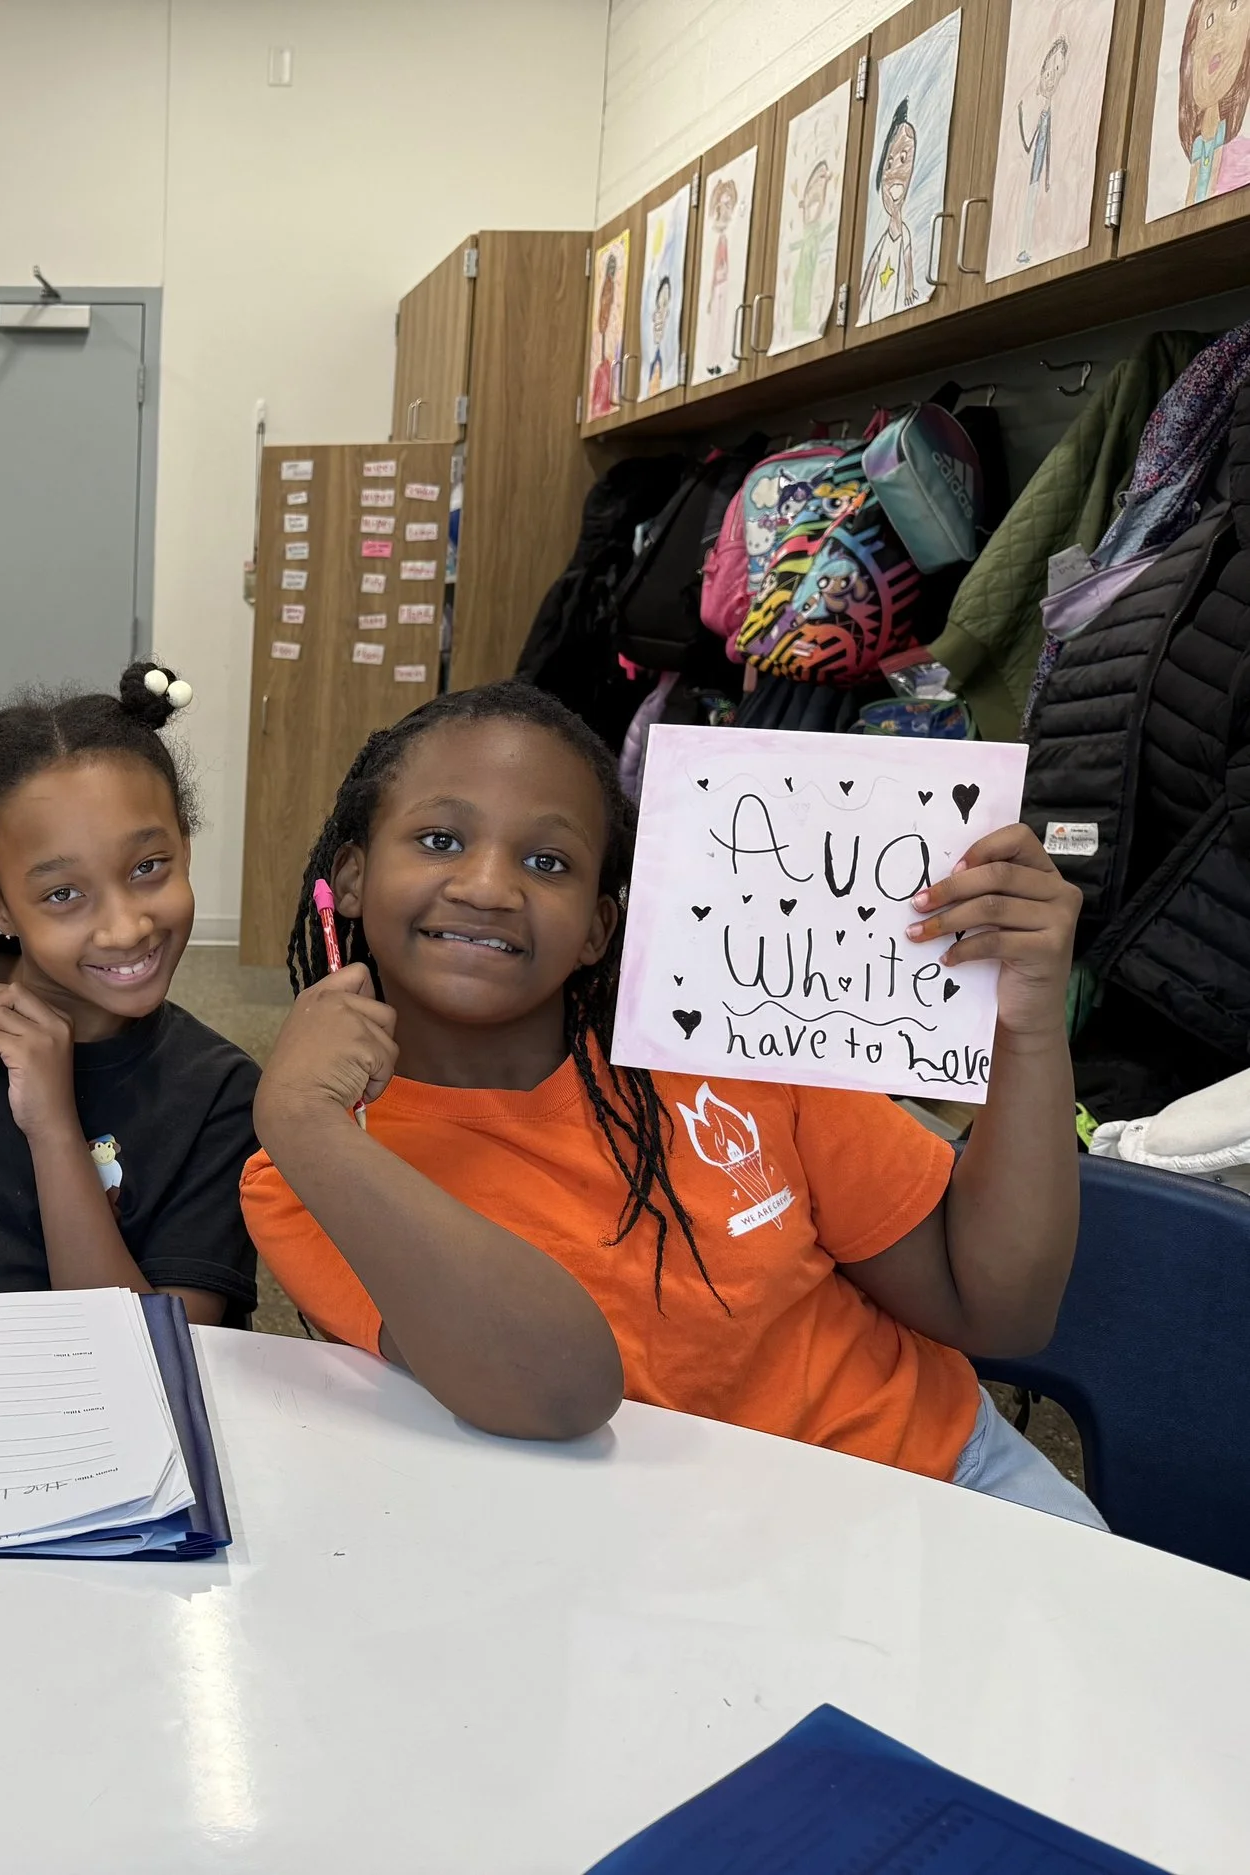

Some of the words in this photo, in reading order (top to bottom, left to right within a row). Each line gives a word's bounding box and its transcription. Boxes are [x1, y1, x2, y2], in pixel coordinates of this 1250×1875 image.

[932, 451, 974, 519] adidas
[723, 925, 942, 1008] White
[726, 1015, 827, 1060] have
[844, 1027, 883, 1064] to
[740, 1213, 756, 1226] WE
[757, 1204, 773, 1219] ARE
[23, 1480, 69, 1495] the
